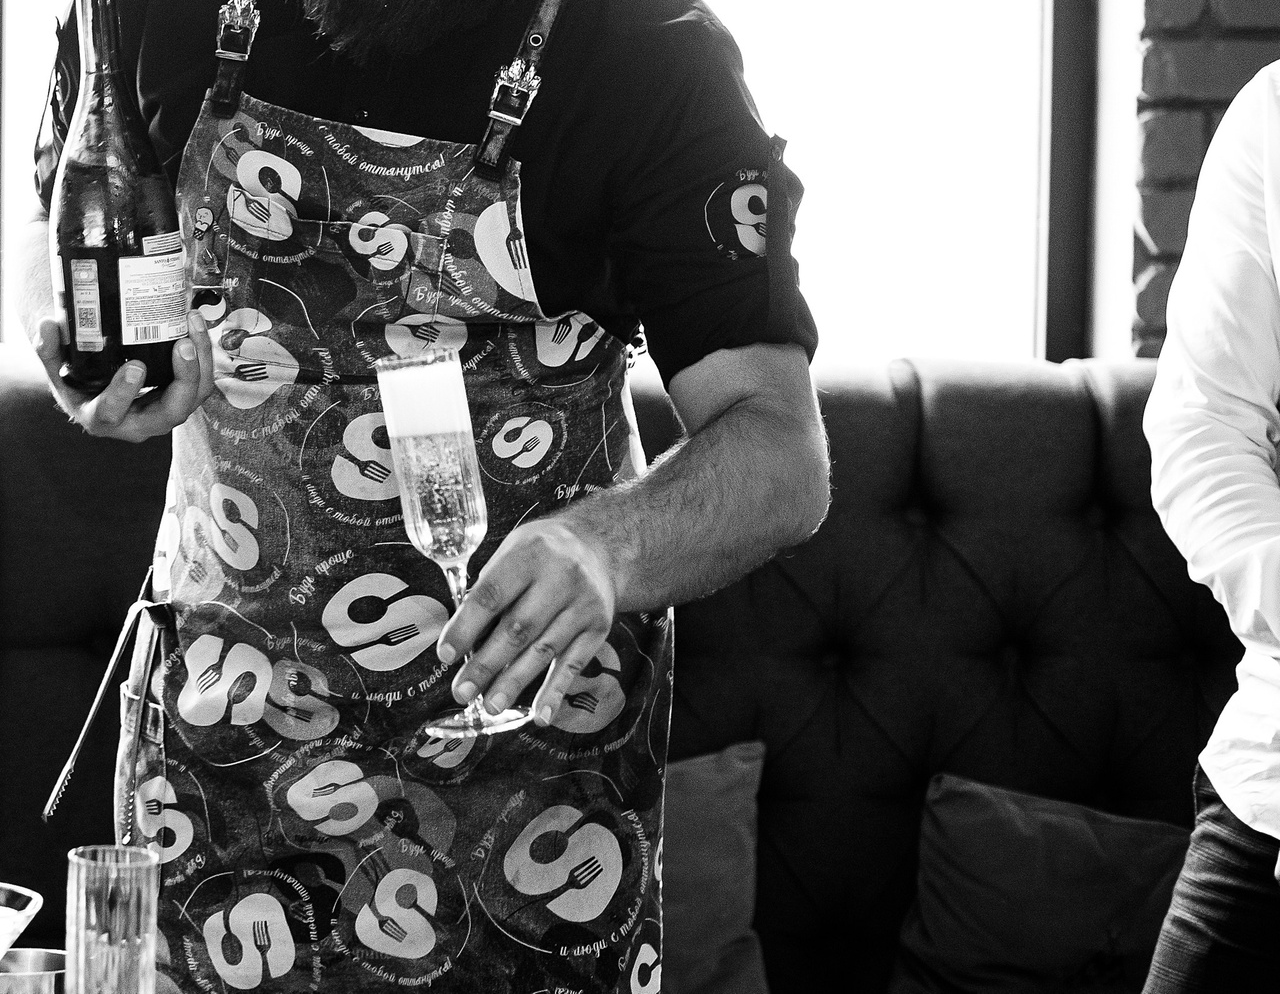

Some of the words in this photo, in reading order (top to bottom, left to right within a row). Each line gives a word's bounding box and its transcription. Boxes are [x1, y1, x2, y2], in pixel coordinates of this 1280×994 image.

[285, 133, 314, 157] проще
[325, 133, 357, 166] тобой
[359, 153, 446, 182] оттянутся!
[419, 661, 450, 693] тобо
